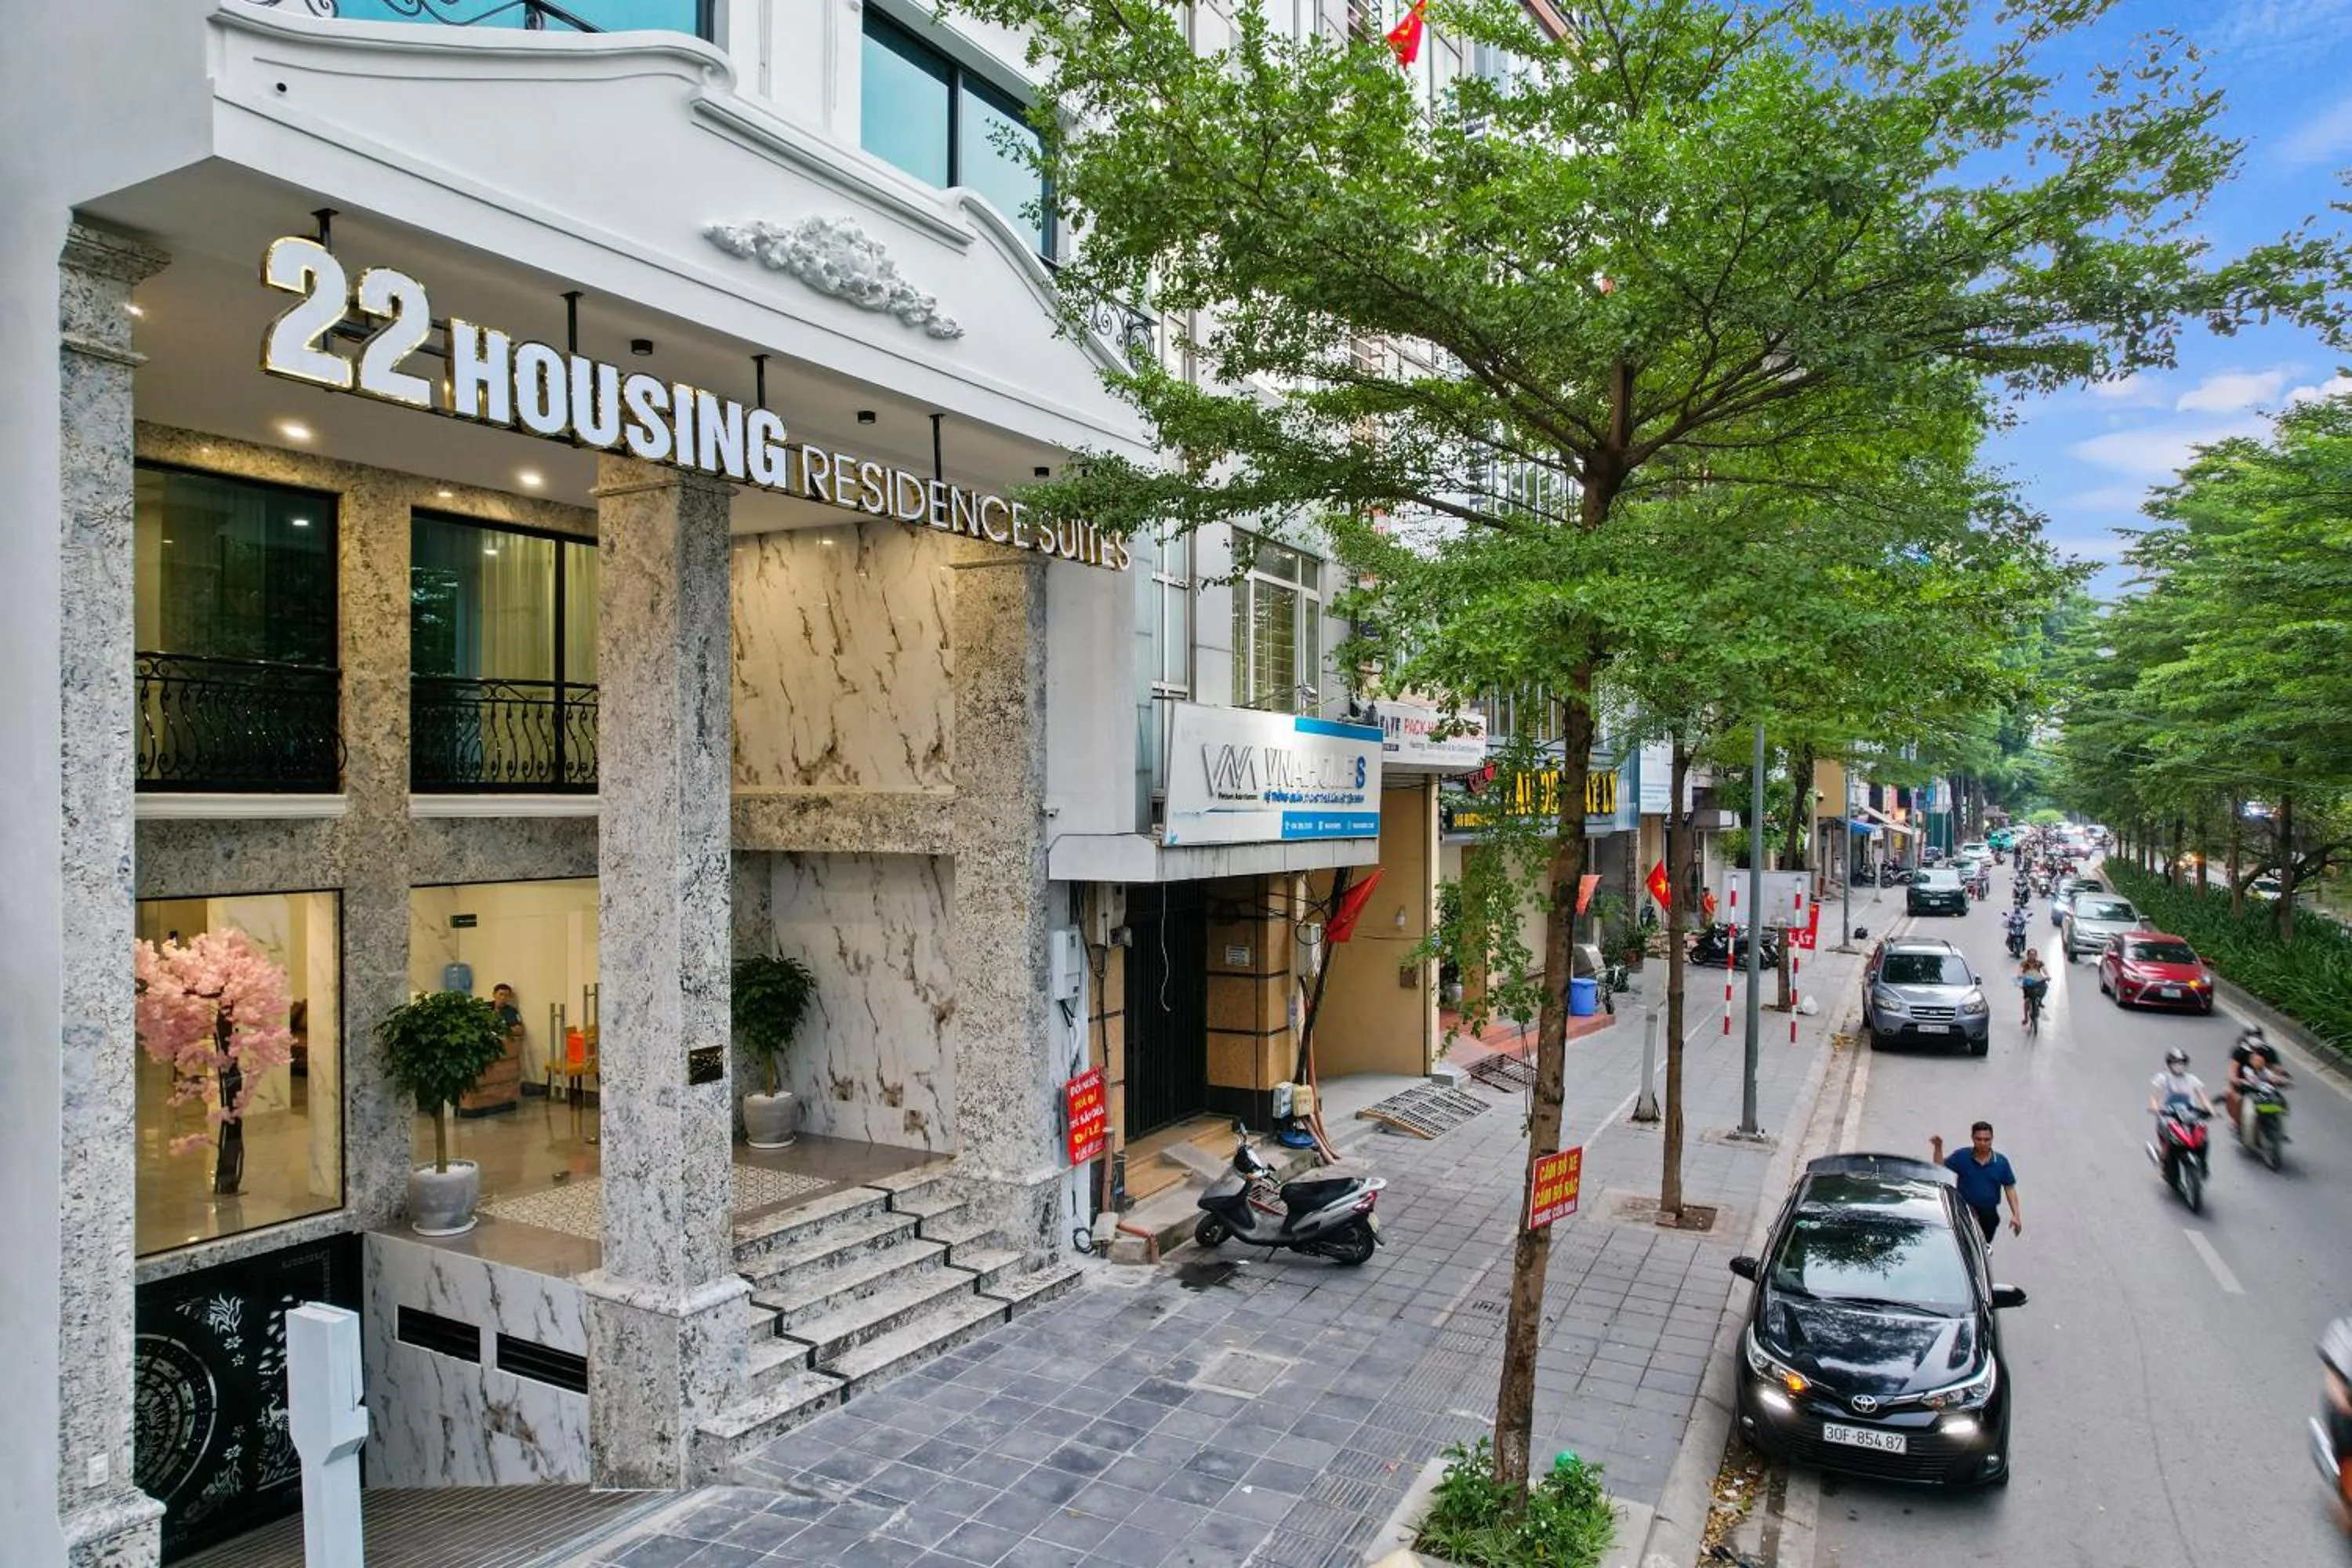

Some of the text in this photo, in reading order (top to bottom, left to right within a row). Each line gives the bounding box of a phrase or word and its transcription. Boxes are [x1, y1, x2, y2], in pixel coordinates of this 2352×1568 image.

[263, 235, 431, 408] 22
[450, 318, 787, 489] HOUSING
[802, 445, 1029, 547] RESIDENCE
[1826, 1426, 1903, 1450] 30F-854.87
